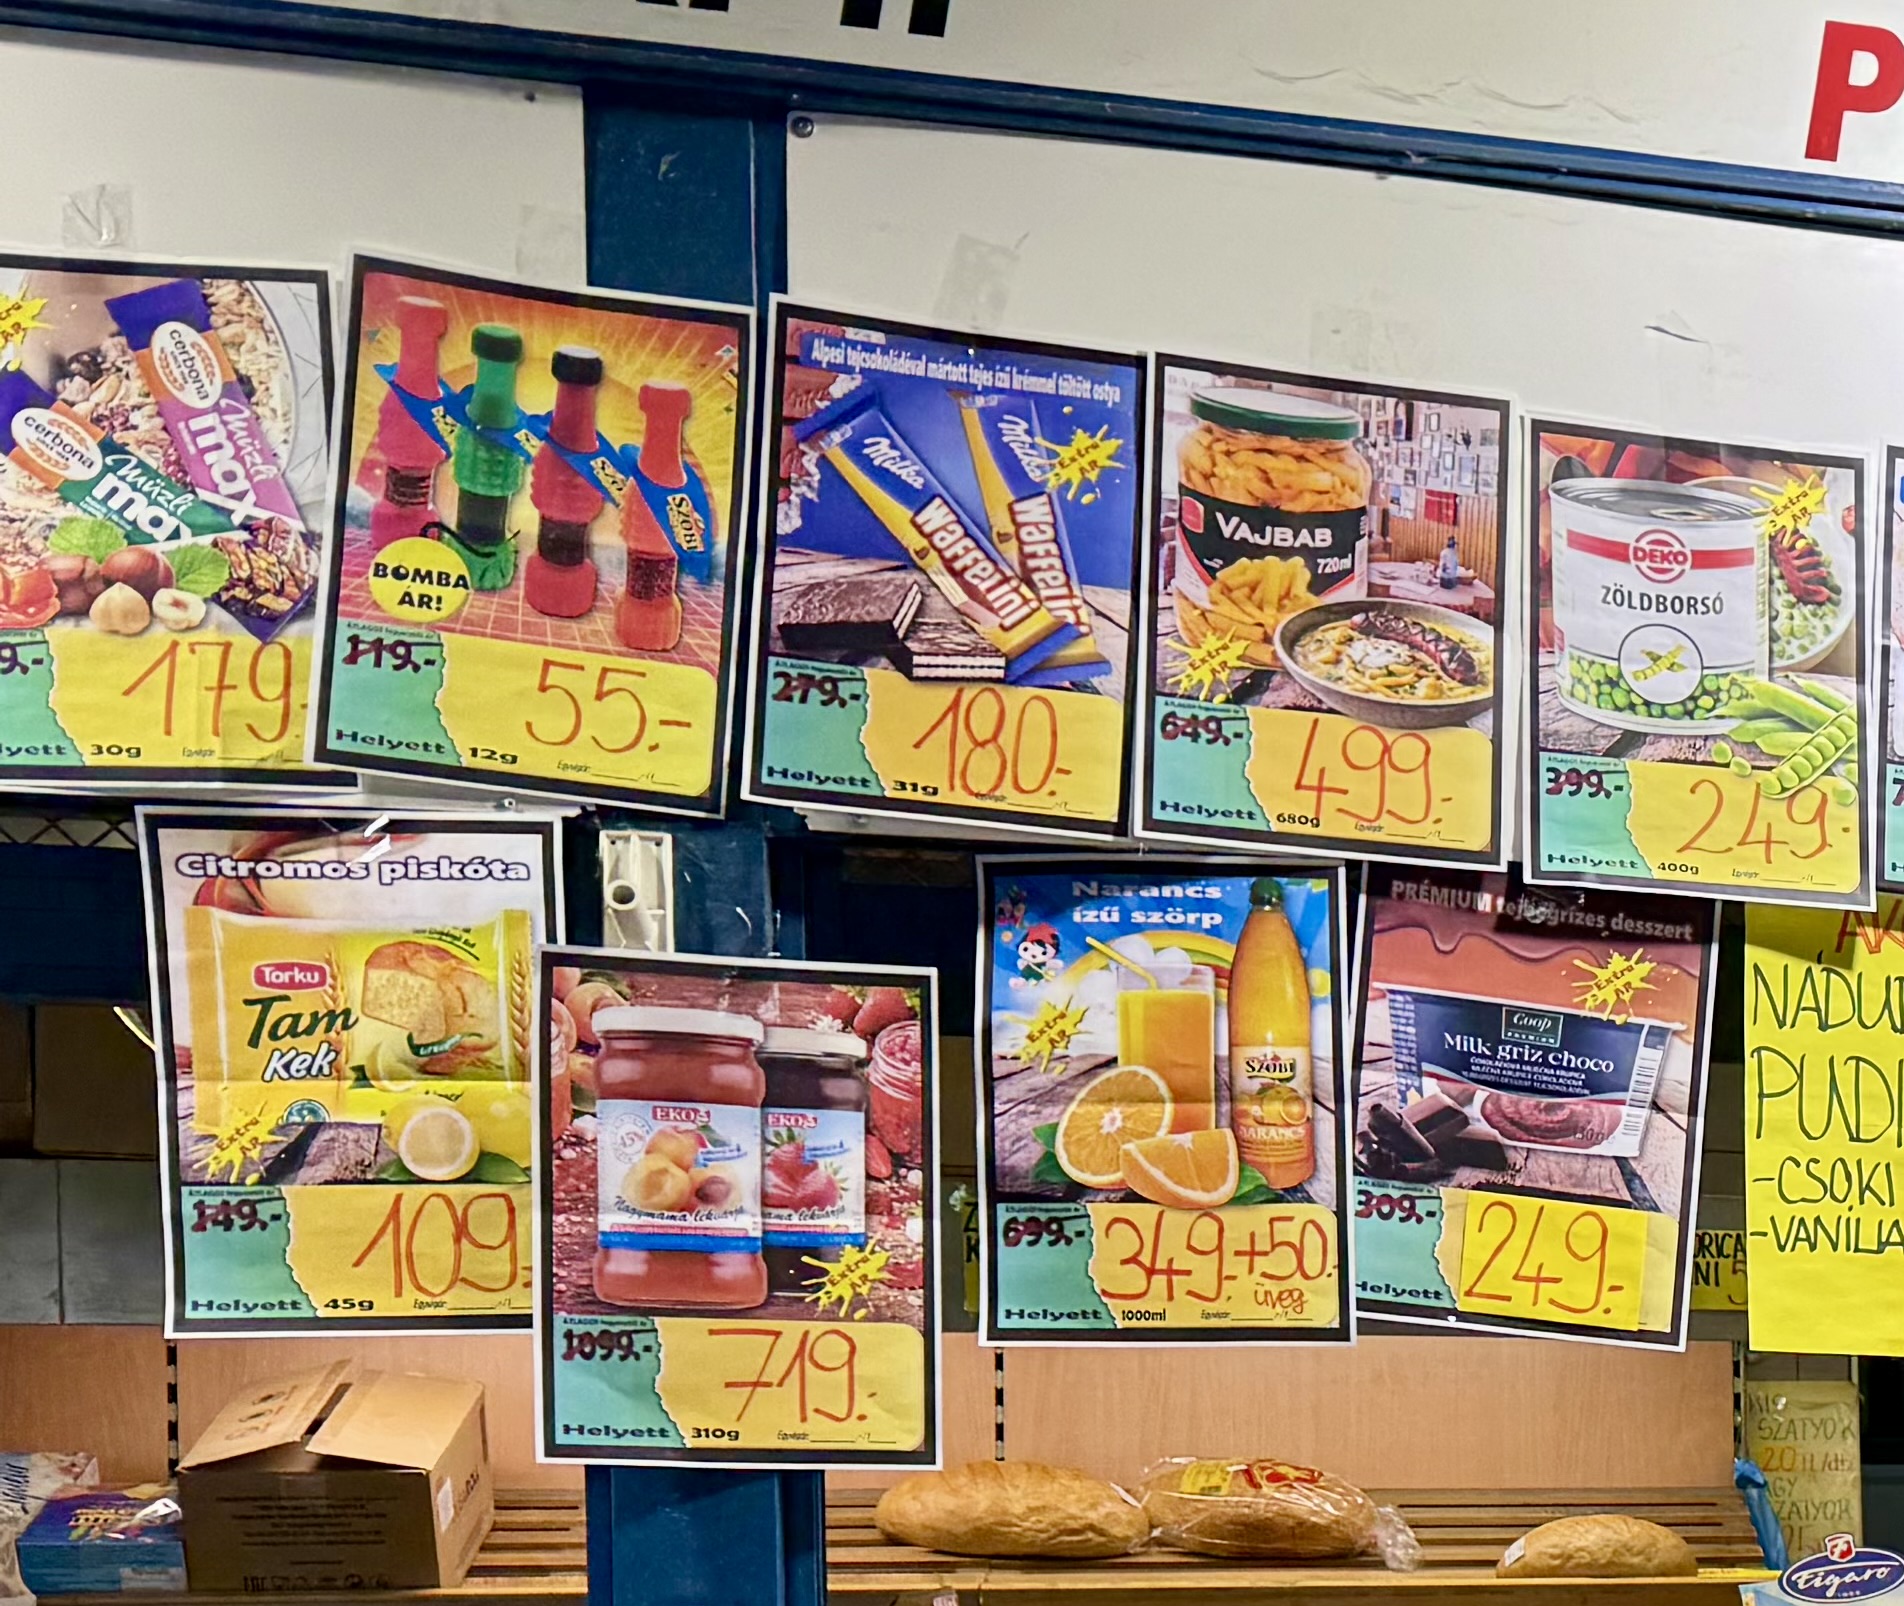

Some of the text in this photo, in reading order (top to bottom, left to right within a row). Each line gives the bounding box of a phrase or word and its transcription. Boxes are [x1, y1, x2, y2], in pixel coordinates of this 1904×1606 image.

[21, 415, 95, 469] cerbona
[864, 437, 924, 489] Milka
[1215, 511, 1333, 548] VAJBAB
[1632, 547, 1688, 566] DEKO
[372, 562, 469, 590] BOMBA
[398, 584, 443, 612] ÁR!
[1600, 585, 1724, 615] ZÖLDBORSÓ
[525, 659, 692, 753] 55.-
[89, 743, 142, 759] 30g
[913, 687, 1072, 797] 180.-
[468, 746, 518, 765] 12g
[176, 854, 531, 885] Citromos piskóta
[1657, 861, 1699, 875] 400g
[1071, 881, 1222, 898] Narancs
[1073, 906, 1223, 928] ízű szörp
[1610, 914, 1694, 940] desszert
[262, 968, 320, 984] Torku
[243, 994, 359, 1050] Tam
[1513, 1012, 1552, 1031] Coop
[263, 1045, 338, 1082] Kek
[1444, 1032, 1615, 1073] Milk griz choco
[323, 1298, 374, 1311] 45g
[1121, 1308, 1167, 1322] 1000ml
[691, 1427, 740, 1442] 310g
[1794, 1566, 1889, 1591] Figaro
